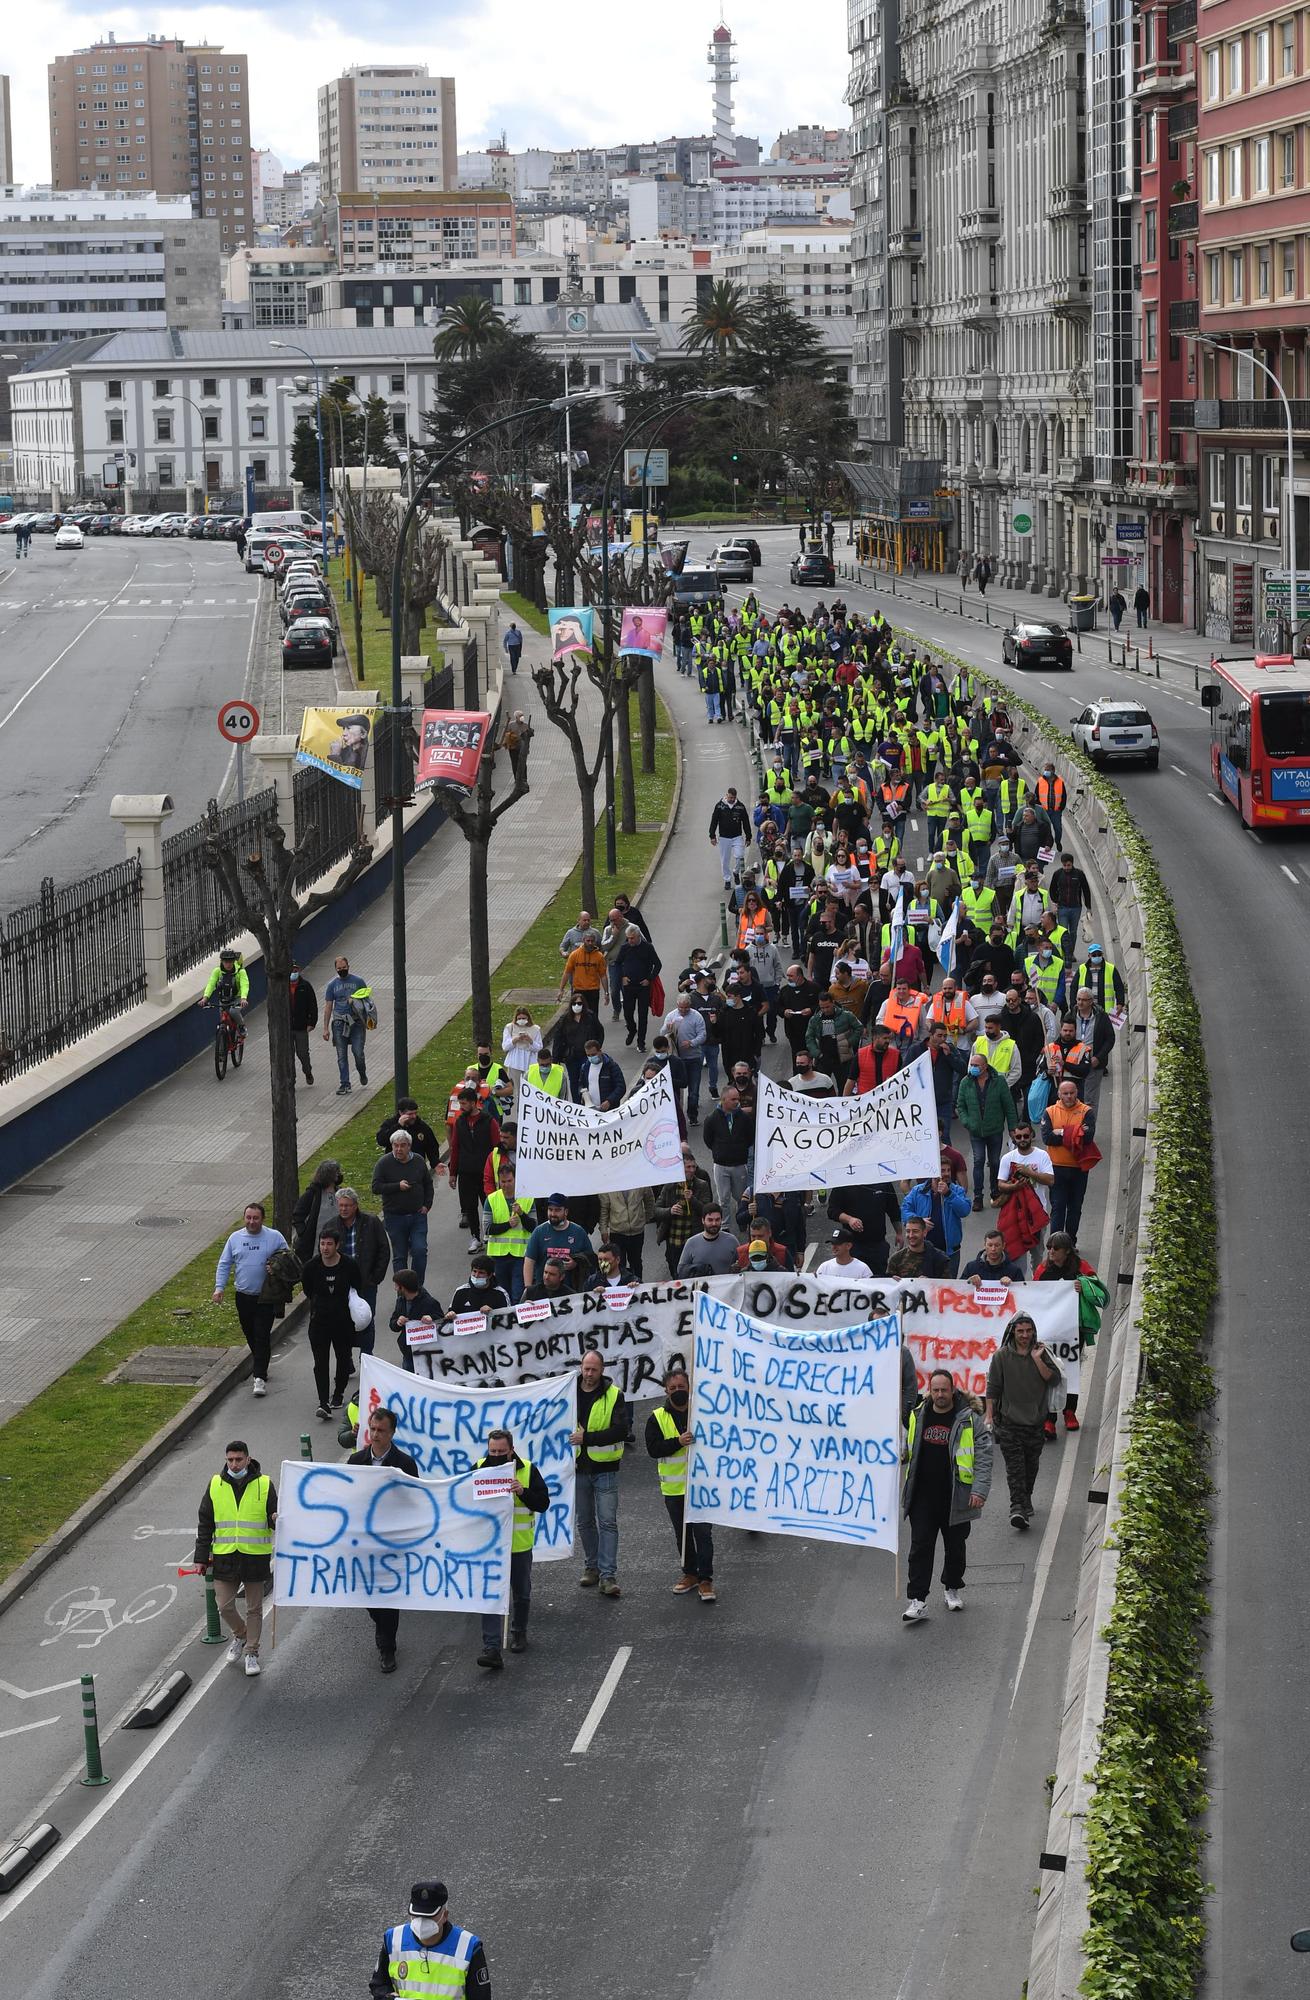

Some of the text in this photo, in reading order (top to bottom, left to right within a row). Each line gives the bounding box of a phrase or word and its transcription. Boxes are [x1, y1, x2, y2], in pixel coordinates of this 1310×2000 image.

[225, 715, 251, 728] 40
[433, 751, 459, 761] IZAL
[522, 1083, 530, 1097] O
[523, 1104, 590, 1128] FUNDEN
[619, 1088, 671, 1121] FLOTA
[767, 1103, 811, 1124] ESTA
[819, 1112, 840, 1124] EN
[521, 1126, 623, 1146] E UNHA MAN
[767, 1126, 788, 1148] A
[793, 1104, 923, 1150] GOBERNAR
[592, 1149, 603, 1160] A
[611, 1139, 643, 1159] BOTA
[517, 1303, 550, 1314] GOBIERNO
[752, 1283, 777, 1317] O
[784, 1284, 891, 1319] SECTOR
[407, 1324, 435, 1334] GOBIERNO
[455, 1315, 486, 1326] GOBIERNO
[700, 1295, 729, 1331] NI
[736, 1314, 763, 1343] DE
[413, 1316, 654, 1382] TRANSPORTISTAS
[696, 1336, 874, 1396] NI DE DERECHA
[698, 1381, 846, 1427] SOMOS LOS DE
[693, 1421, 898, 1465] ABAJO Y VAMOS
[474, 1478, 513, 1486] GOBIERNO
[692, 1453, 758, 1483] A POR
[690, 1485, 721, 1509] LOS
[730, 1486, 757, 1511] DE
[291, 1467, 504, 1559] S.O.S.
[276, 1552, 503, 1600] TRANSPORTE
